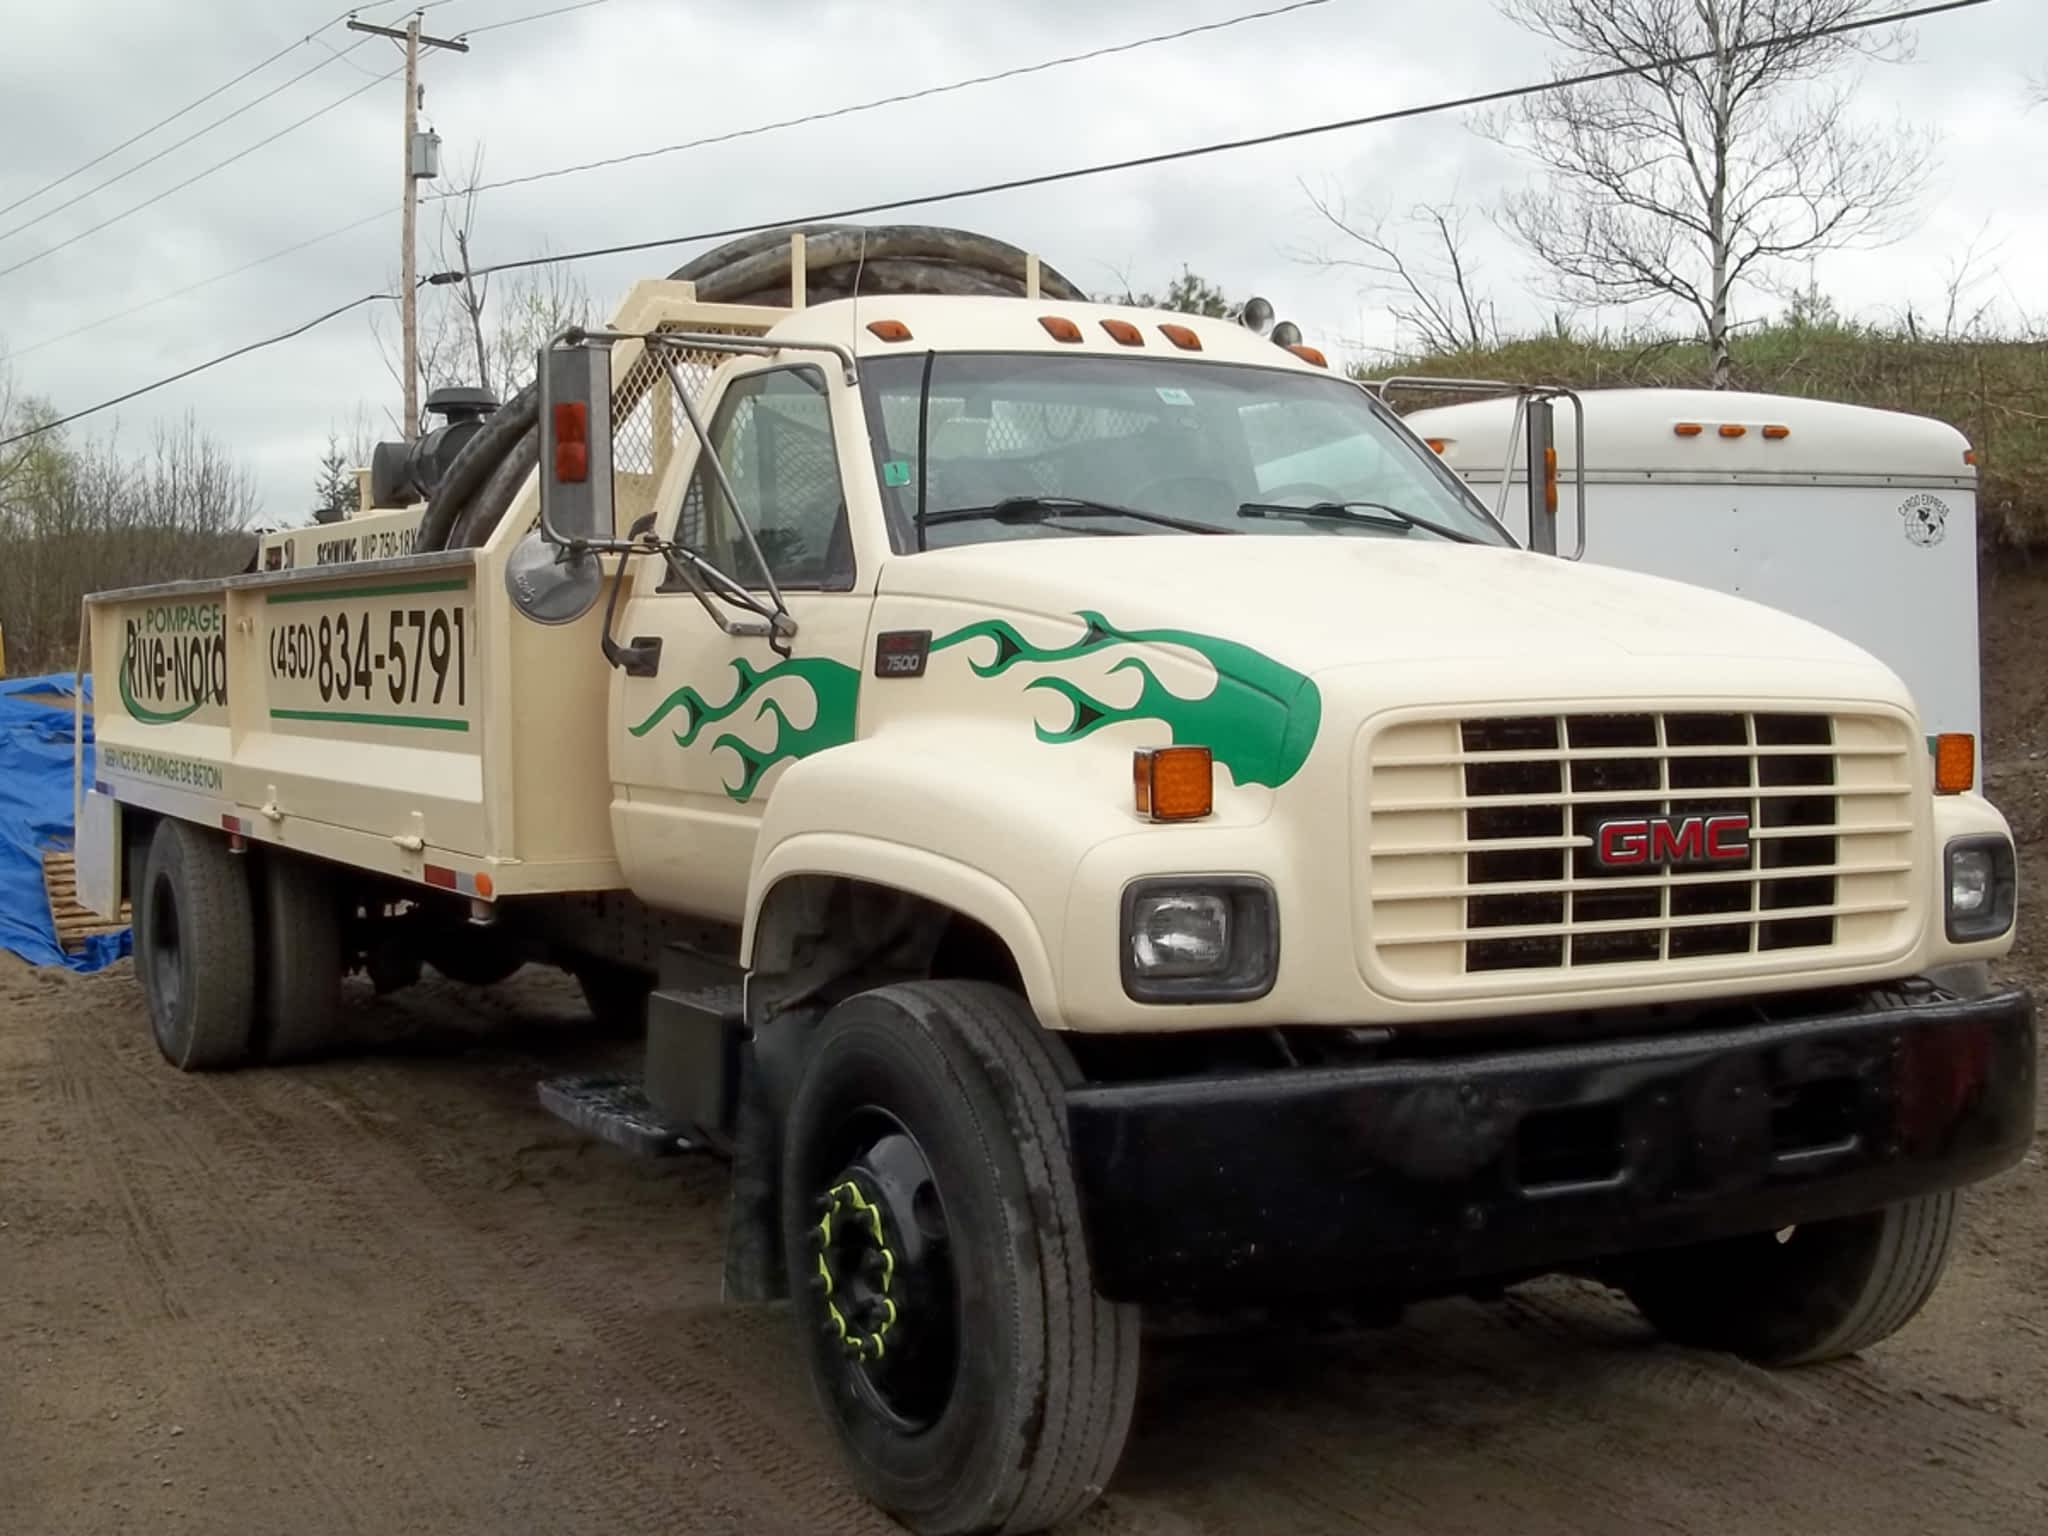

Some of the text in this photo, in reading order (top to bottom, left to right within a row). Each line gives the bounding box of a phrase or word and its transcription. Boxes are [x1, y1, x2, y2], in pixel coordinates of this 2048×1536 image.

[1921, 493, 1951, 518] EXPRESS
[146, 603, 220, 634] POMPAGE
[126, 613, 229, 708] Rive-Nord
[269, 606, 466, 707] (450) 834-5791
[886, 654, 920, 672] 7500
[142, 754, 180, 782] POMPAGE
[181, 761, 192, 785] DE
[1598, 814, 1749, 865] GMC
